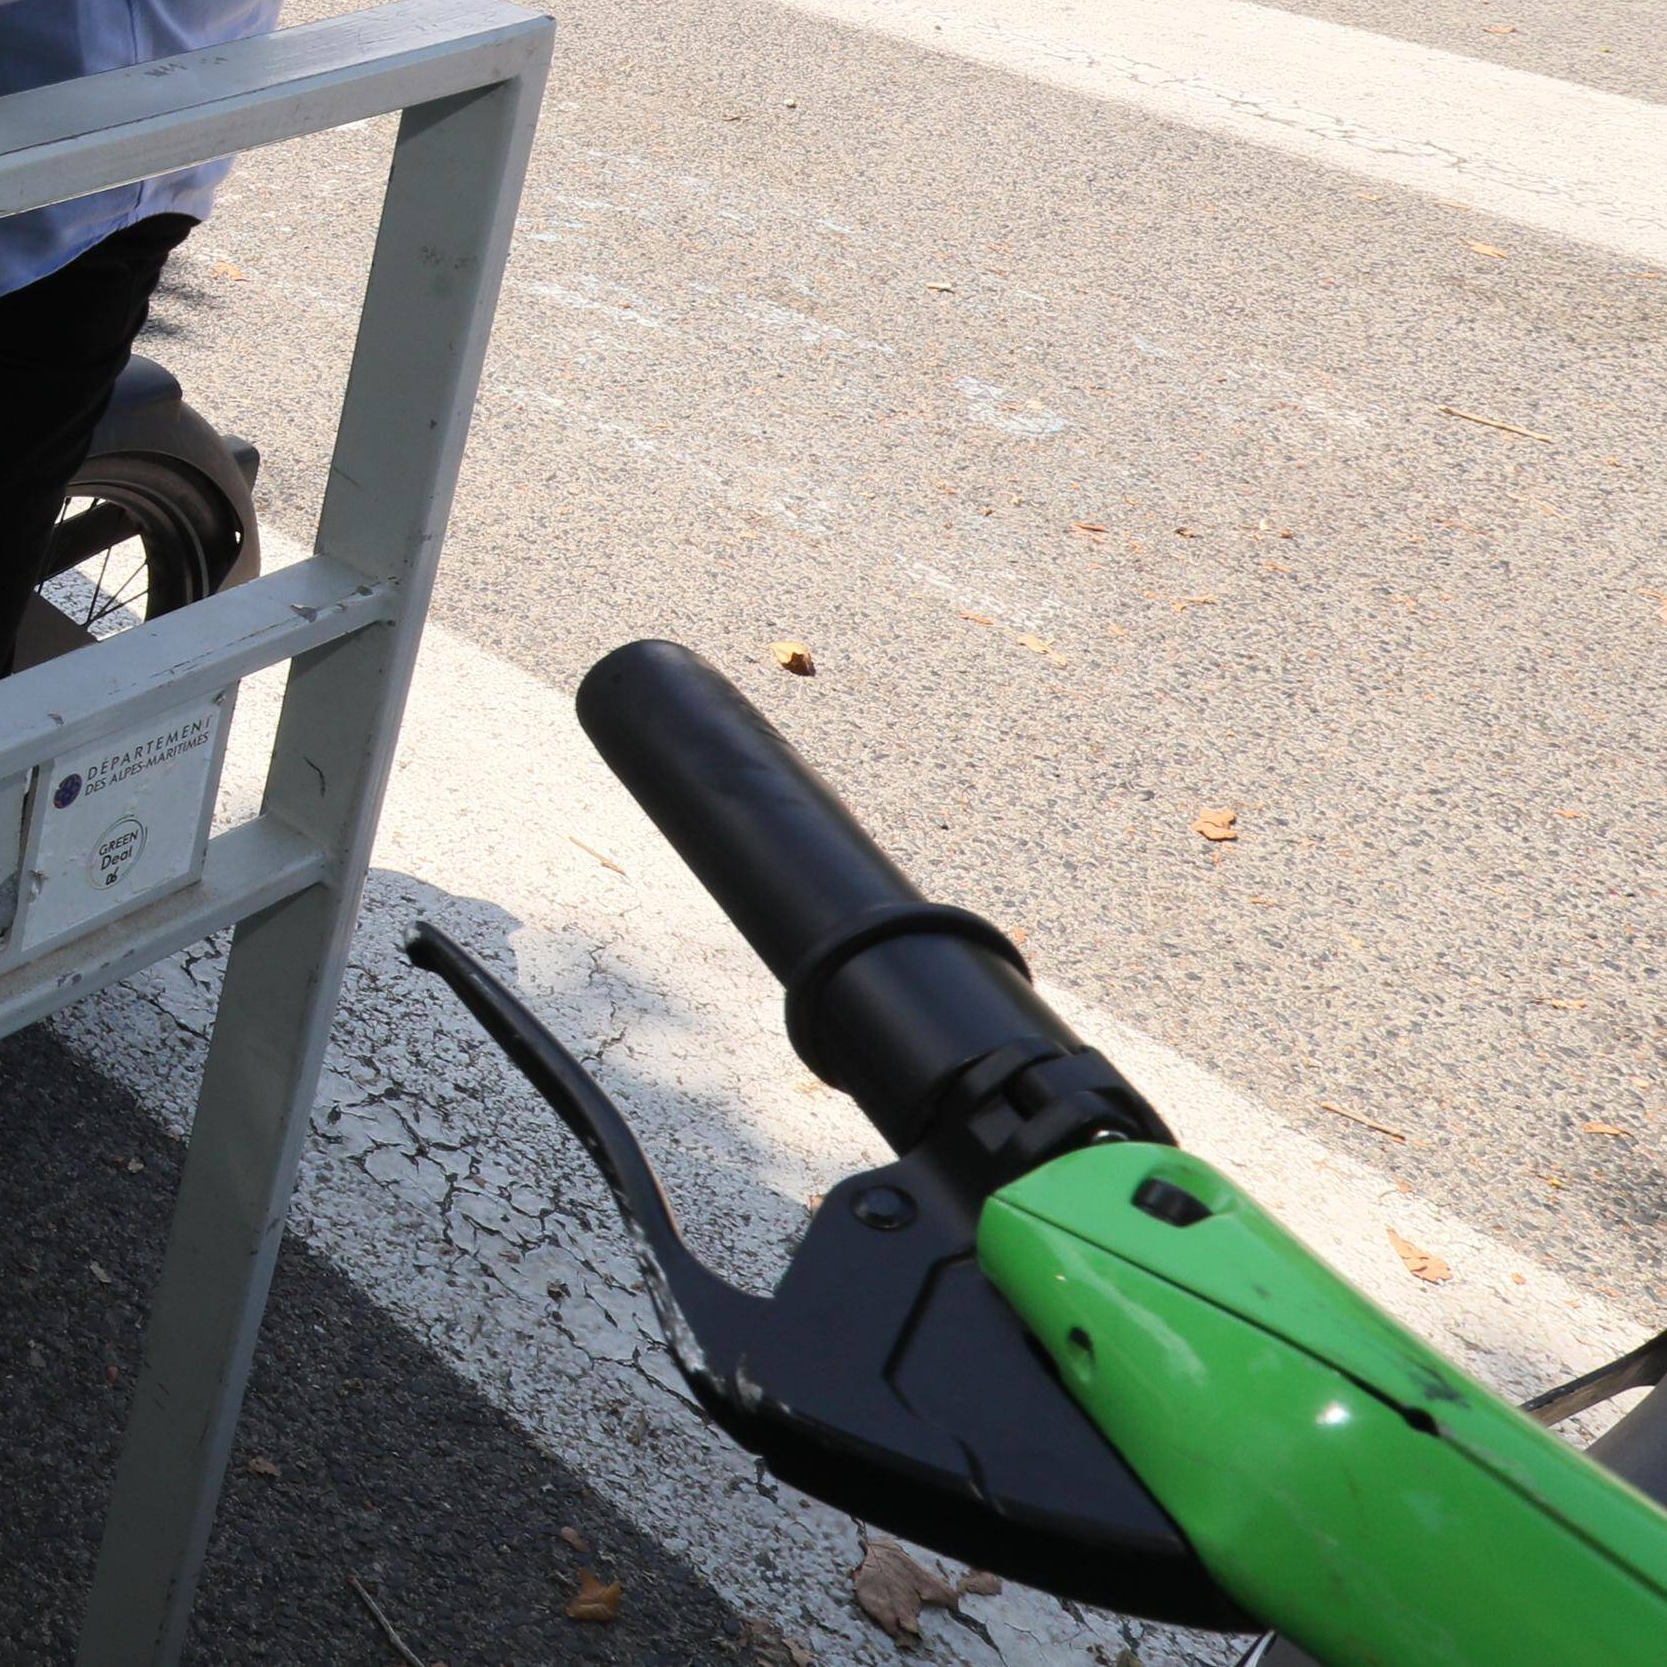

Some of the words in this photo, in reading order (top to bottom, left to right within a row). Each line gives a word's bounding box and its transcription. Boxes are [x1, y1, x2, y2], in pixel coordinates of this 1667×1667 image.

[85, 777, 107, 796] DES
[110, 731, 209, 786] ALPES-MARITIMES
[98, 829, 139, 856] GREEN
[100, 845, 133, 871] Deal
